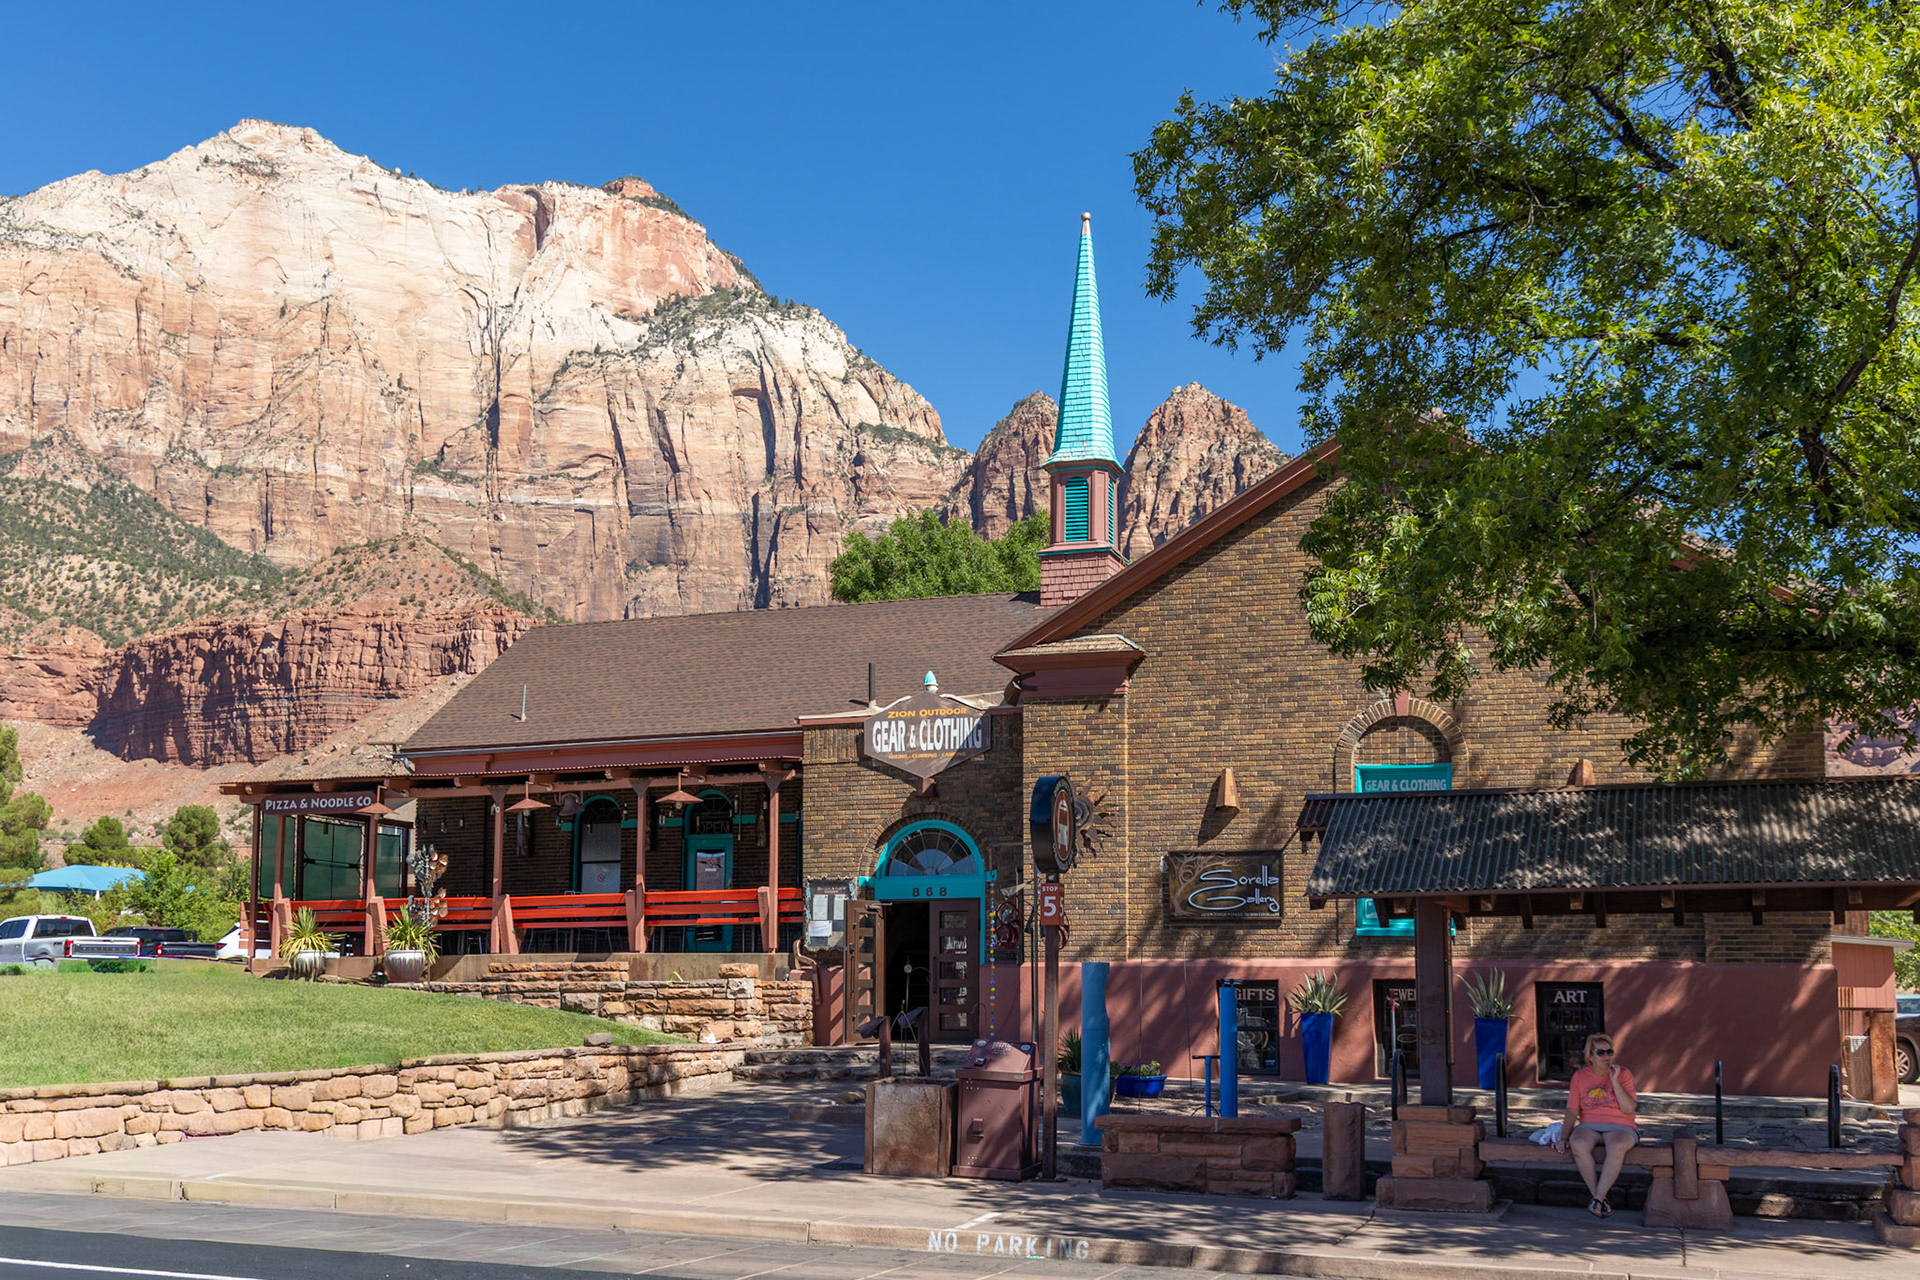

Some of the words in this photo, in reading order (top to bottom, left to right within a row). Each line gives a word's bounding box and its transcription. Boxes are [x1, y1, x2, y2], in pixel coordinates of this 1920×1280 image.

[887, 710, 916, 719] ZION
[919, 708, 968, 717] OUTDOOR
[872, 720, 906, 753] GEAR
[909, 724, 917, 748] &
[919, 717, 983, 751] CLOTHING
[1364, 780, 1390, 792] GEAR
[1391, 780, 1398, 791] &
[1400, 779, 1447, 791] CLOTHING
[265, 800, 297, 810] PIZZA
[299, 799, 308, 809] &
[311, 797, 354, 808] NOODLE
[356, 796, 372, 806] CO
[1200, 865, 1279, 888] Sorella
[912, 887, 947, 897] 868
[1043, 896, 1057, 917] 5
[1188, 888, 1280, 912] Gallery
[1234, 988, 1275, 1001] GIFTS
[1553, 990, 1588, 1003] ART
[928, 1231, 958, 1252] NO
[976, 1233, 1090, 1259] PARKING
